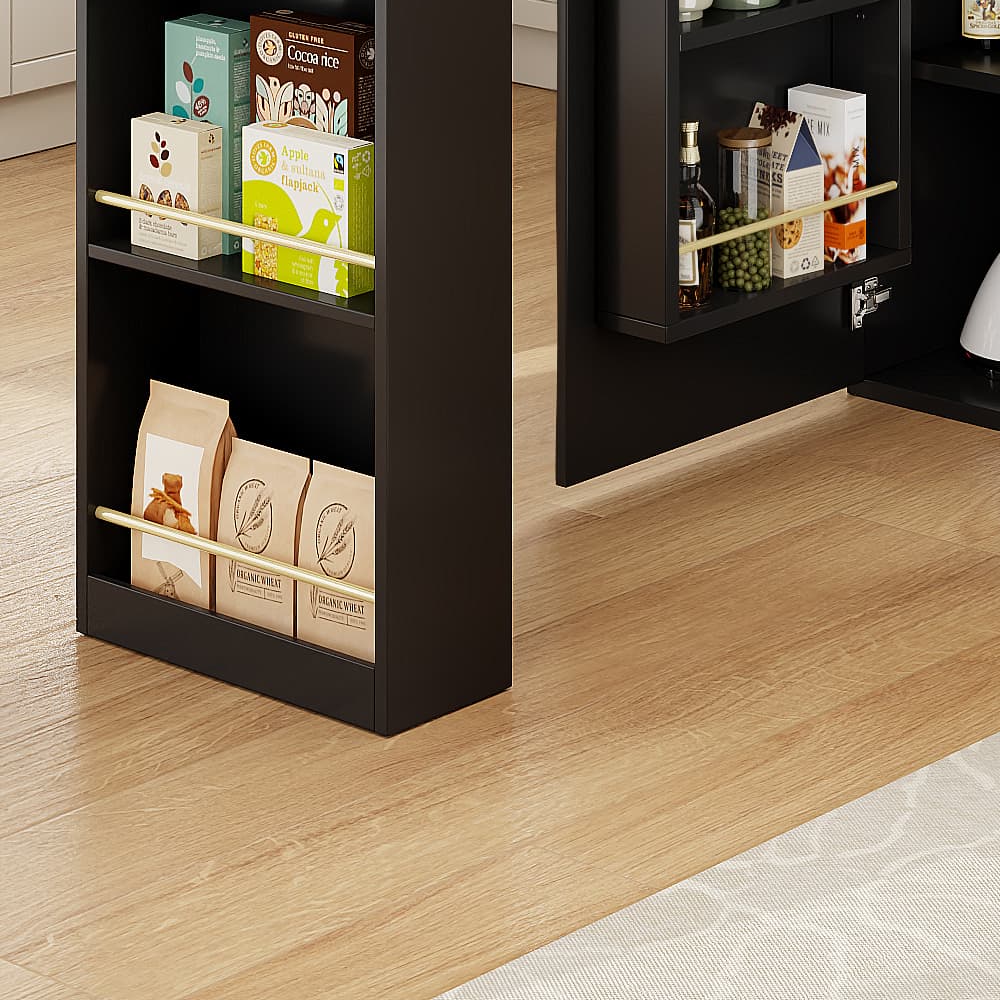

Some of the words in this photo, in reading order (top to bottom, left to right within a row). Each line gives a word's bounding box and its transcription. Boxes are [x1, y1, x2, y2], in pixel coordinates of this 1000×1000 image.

[288, 31, 309, 41] GLUTEN
[310, 35, 325, 45] FREE
[287, 44, 319, 65] Cocoa
[320, 52, 340, 69] rice
[817, 119, 830, 137] MIX
[281, 145, 309, 161] Apple
[290, 164, 326, 180] sultana
[281, 174, 319, 193] flapjack
[236, 569, 260, 584] ORGANIC
[260, 576, 281, 589] WHEAT
[319, 595, 343, 610] ORGANIC
[343, 602, 365, 615] WHEAT
